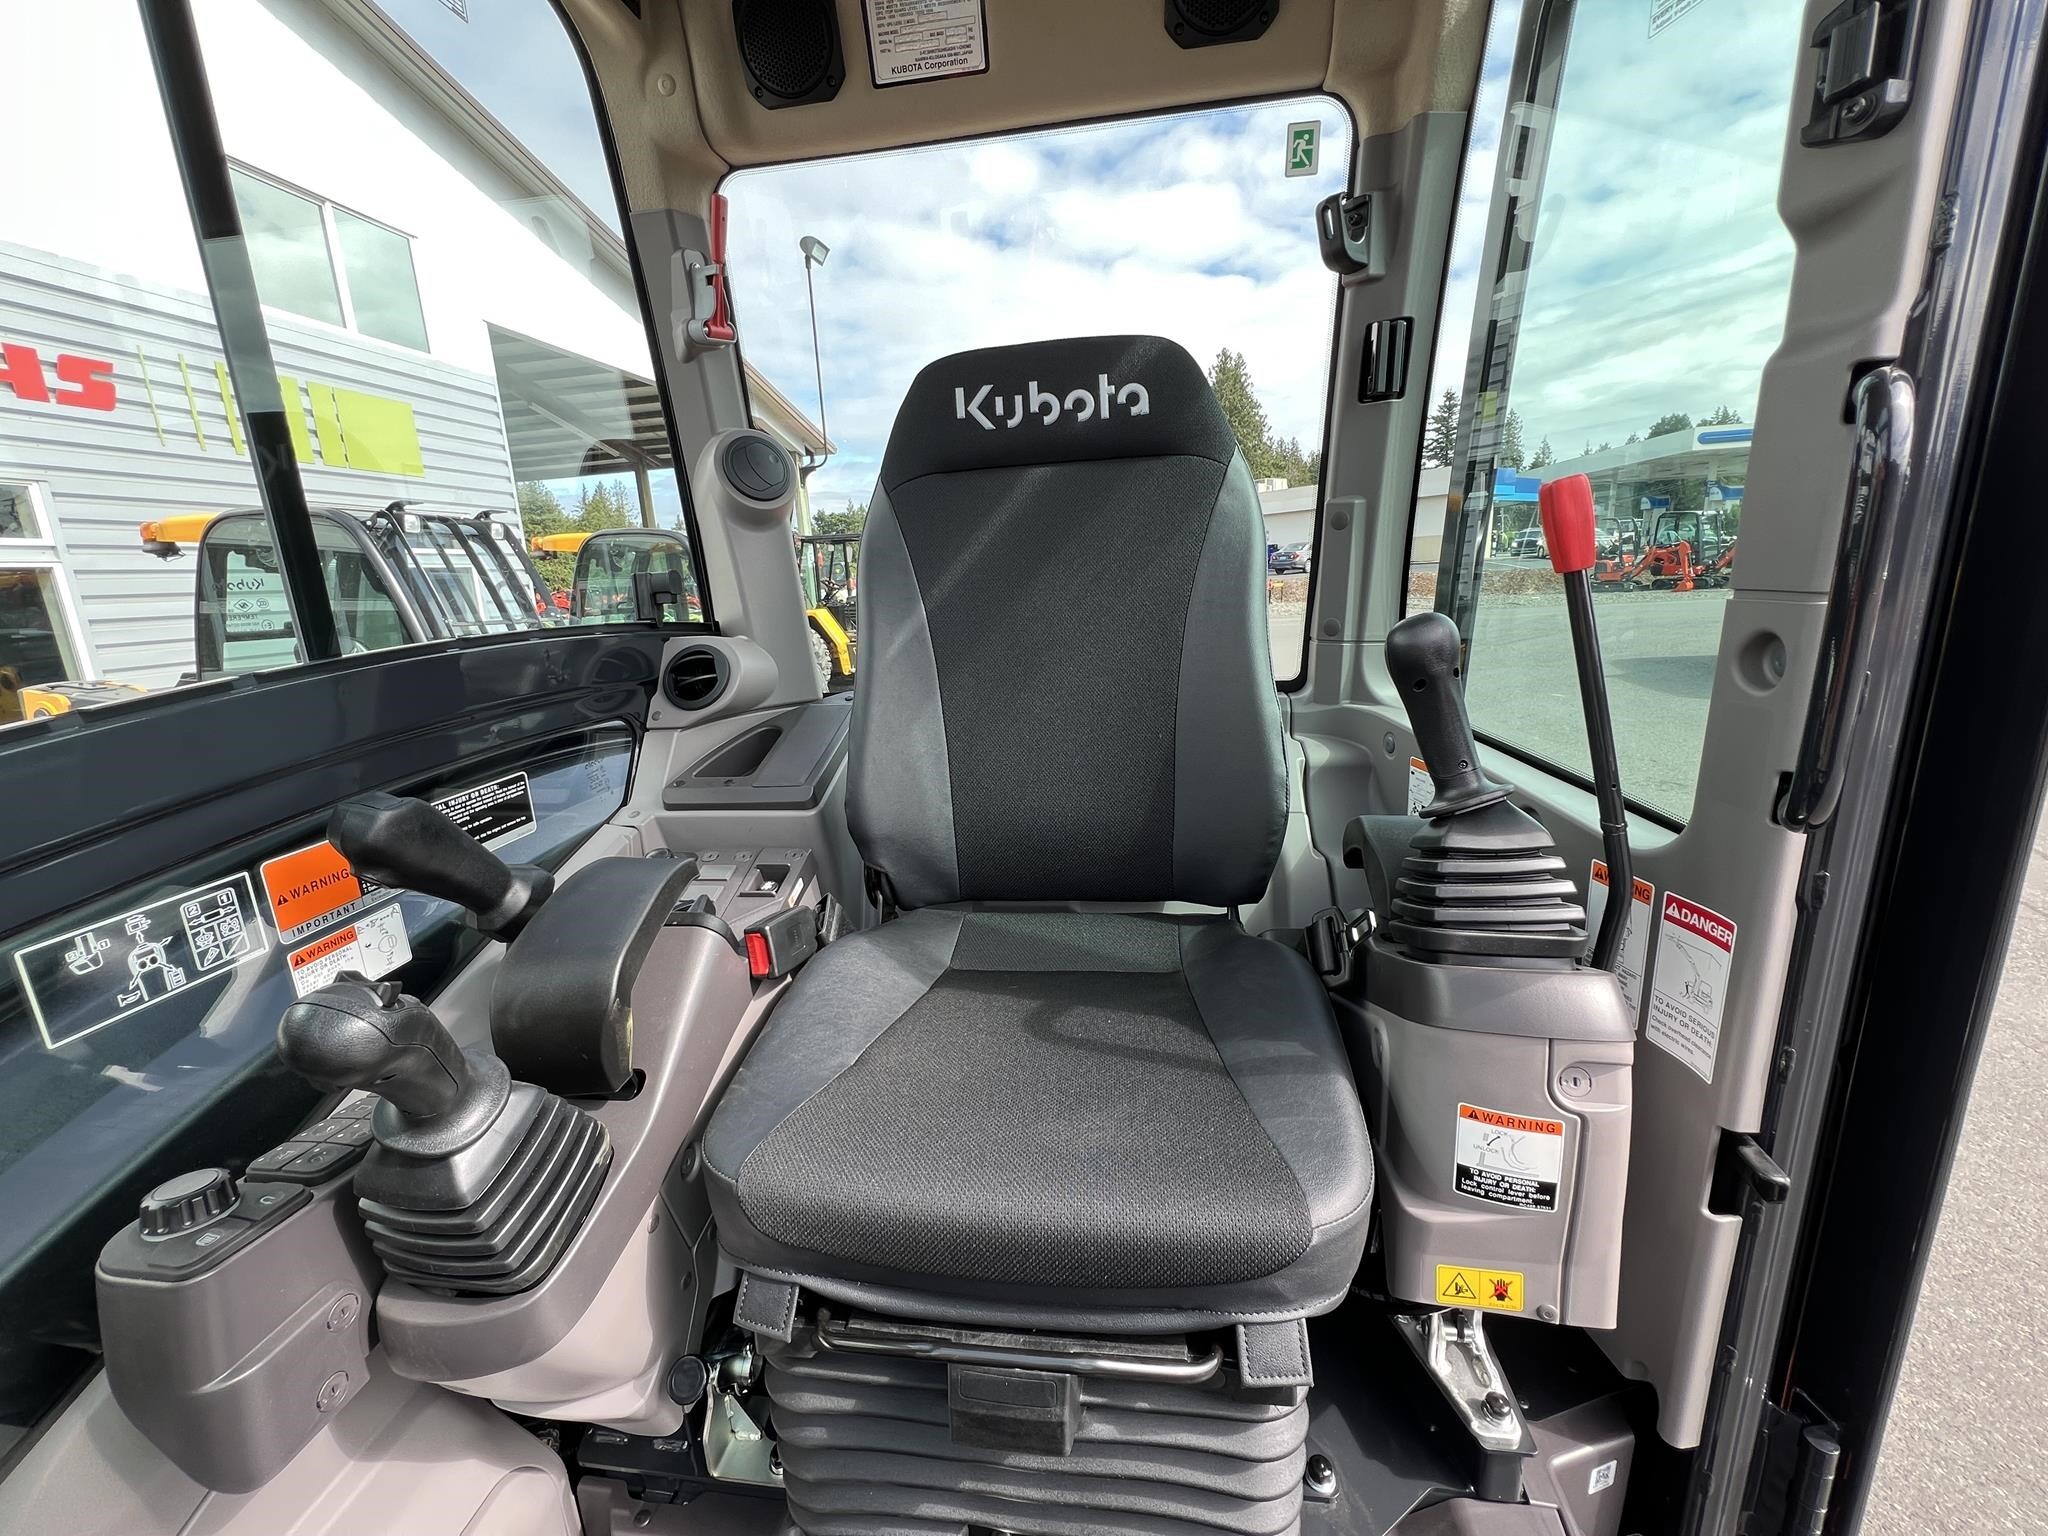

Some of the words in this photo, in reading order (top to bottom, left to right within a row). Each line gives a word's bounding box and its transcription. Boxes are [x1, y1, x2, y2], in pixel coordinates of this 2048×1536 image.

[891, 63, 923, 75] KUBOTA
[924, 57, 969, 71] Corporation
[955, 373, 1150, 430] Kubota
[448, 794, 470, 807] INJURY
[470, 791, 480, 799] OR
[289, 868, 350, 900] WARNING
[292, 902, 358, 938] IMPORTANT
[1680, 908, 1733, 946] DANGER
[306, 931, 355, 960] WARNING
[1653, 1004, 1678, 1022] INJURY
[1679, 1019, 1690, 1030] OR
[1654, 995, 1664, 1005] TO
[1665, 1002, 1688, 1018] AVOID
[1688, 1015, 1715, 1040] SERIOUS
[1482, 1111, 1556, 1133] WARNING
[1490, 1128, 1508, 1136] LOCK
[1473, 1143, 1498, 1153] UNLOCK
[1469, 1167, 1480, 1175] TO
[1481, 1171, 1502, 1180] AVOID
[1504, 1176, 1540, 1187] PERSONAL
[1473, 1175, 1497, 1186] INJURY
[1499, 1181, 1510, 1189] OR
[1511, 1184, 1536, 1193] DEATH:
[1460, 1183, 1485, 1196] leaving
[1461, 1178, 1478, 1187] Lock
[1480, 1183, 1505, 1193] control
[1507, 1189, 1526, 1197] lever
[1528, 1192, 1551, 1201] before
